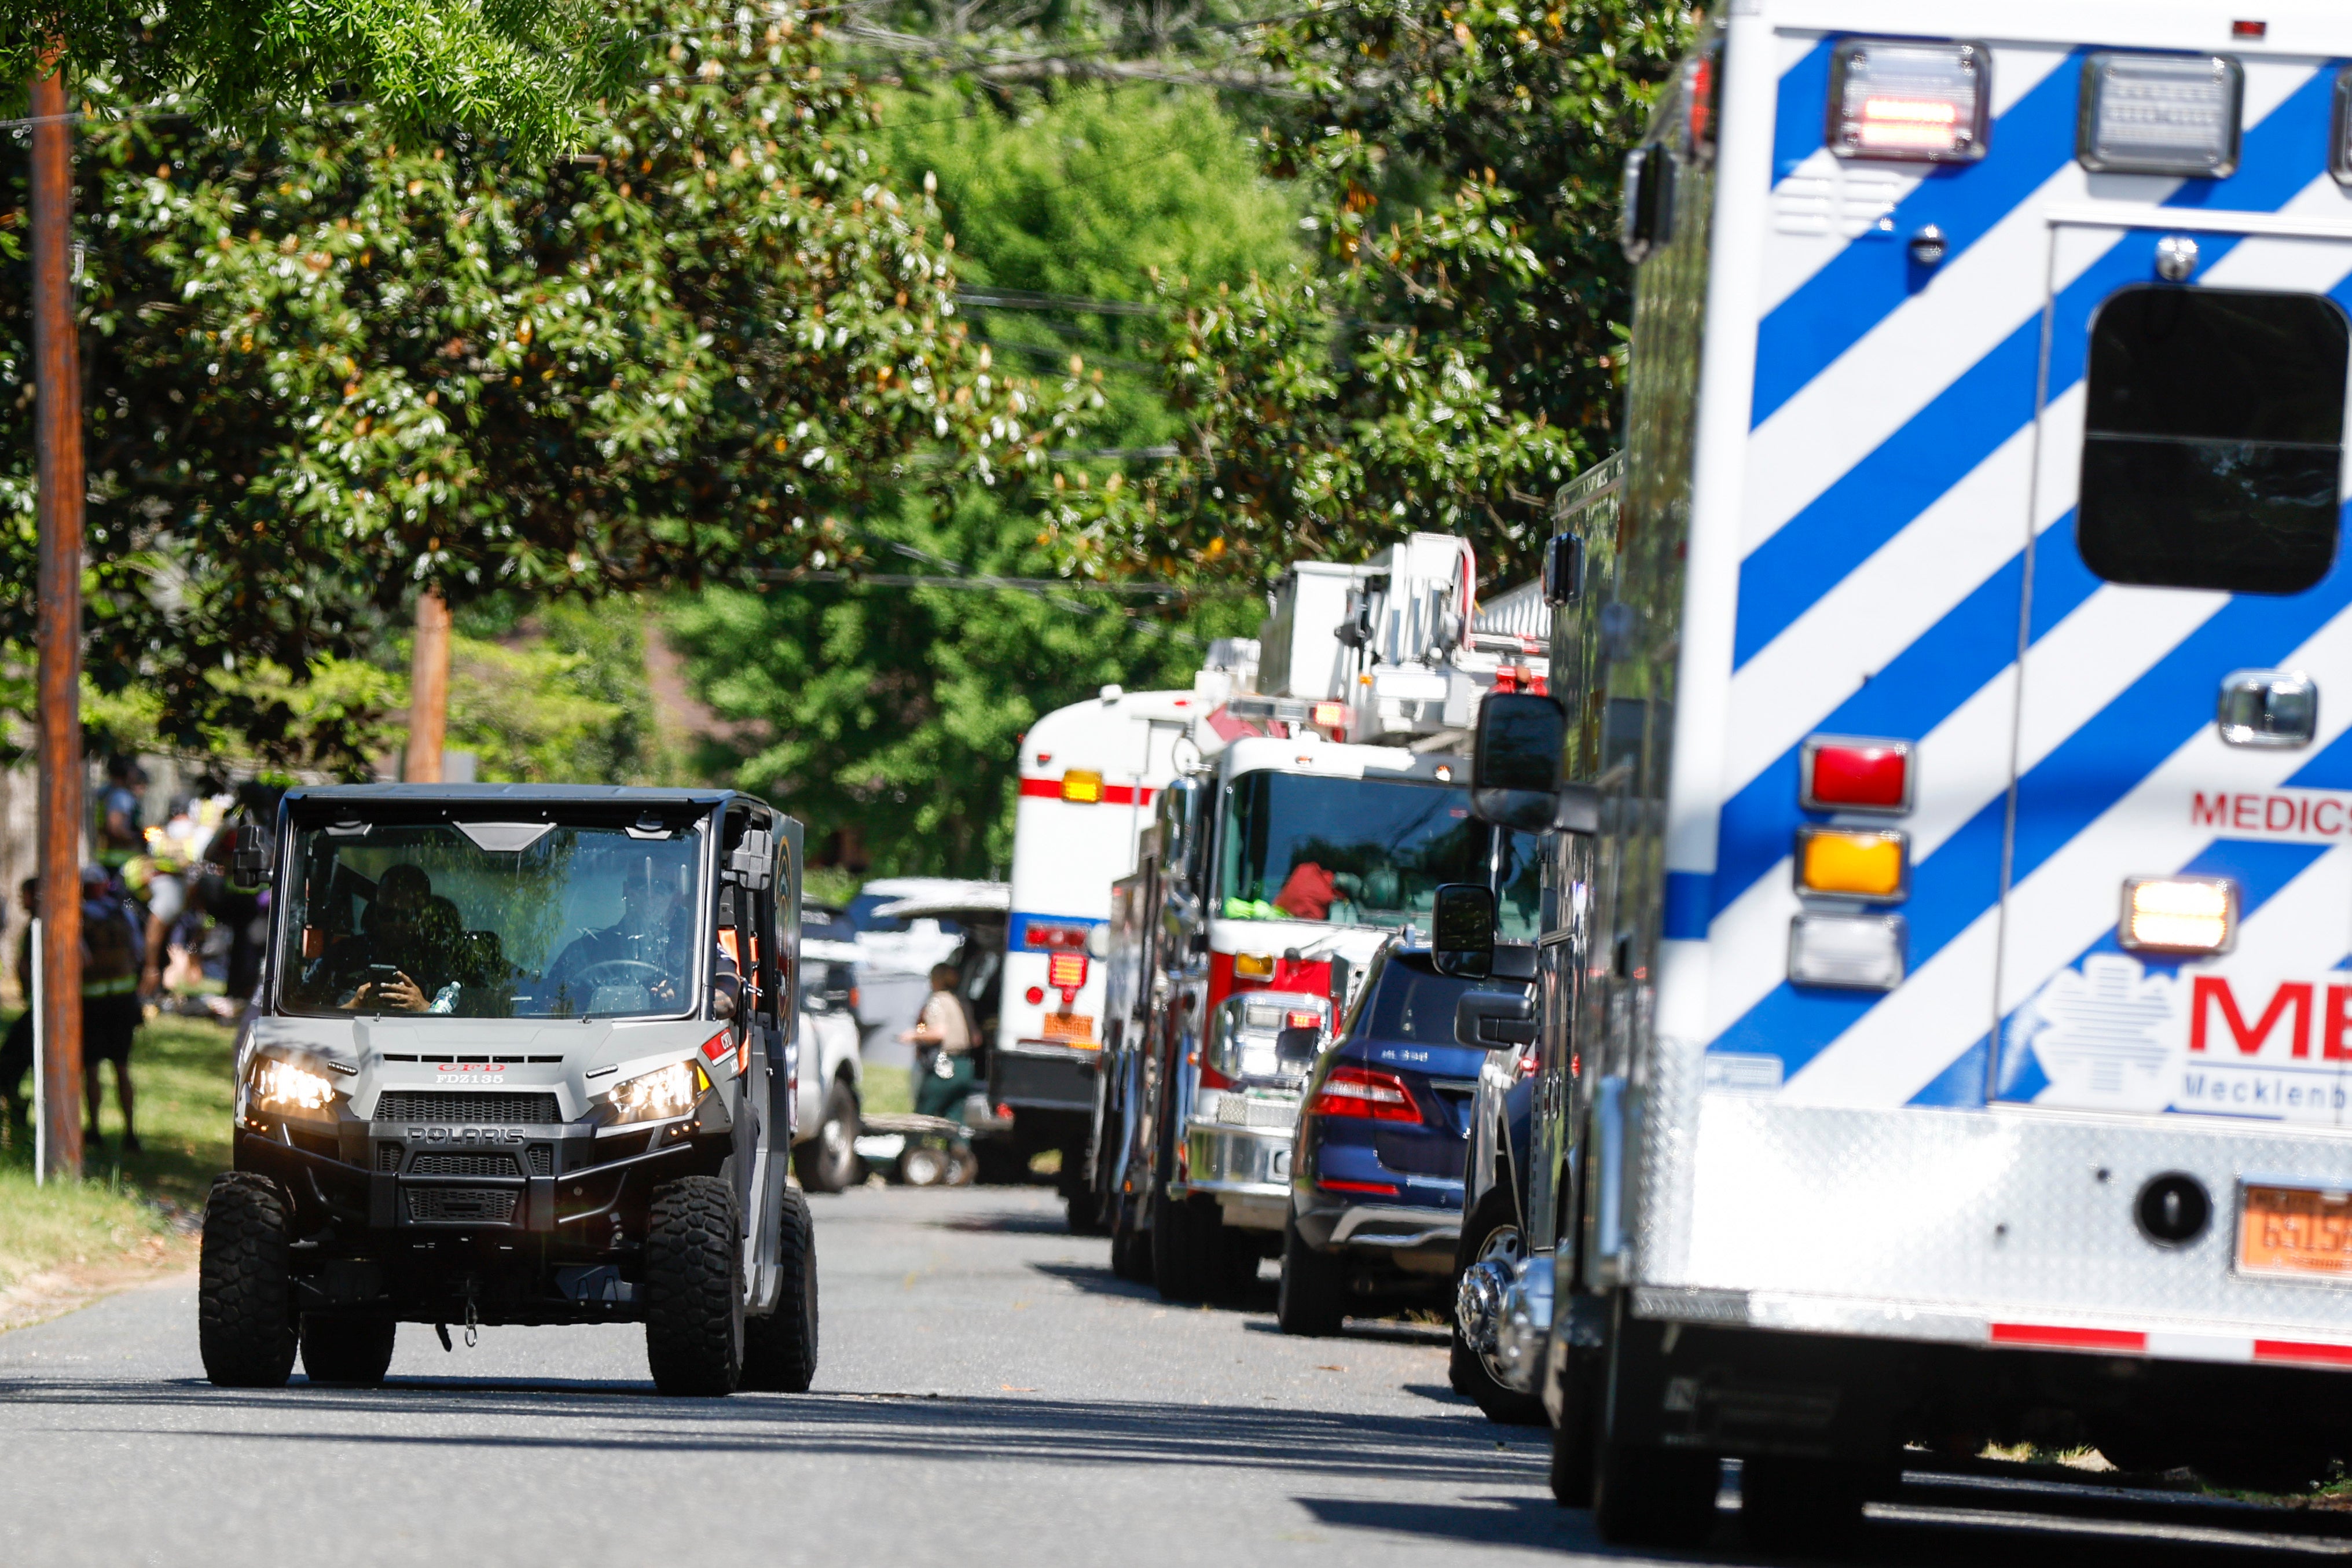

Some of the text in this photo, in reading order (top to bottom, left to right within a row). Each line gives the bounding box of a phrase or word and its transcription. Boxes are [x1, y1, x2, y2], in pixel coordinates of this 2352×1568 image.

[2191, 791, 2352, 836] MEDIC
[436, 1074, 504, 1084] FDZ135
[407, 1128, 524, 1144] POLARIS
